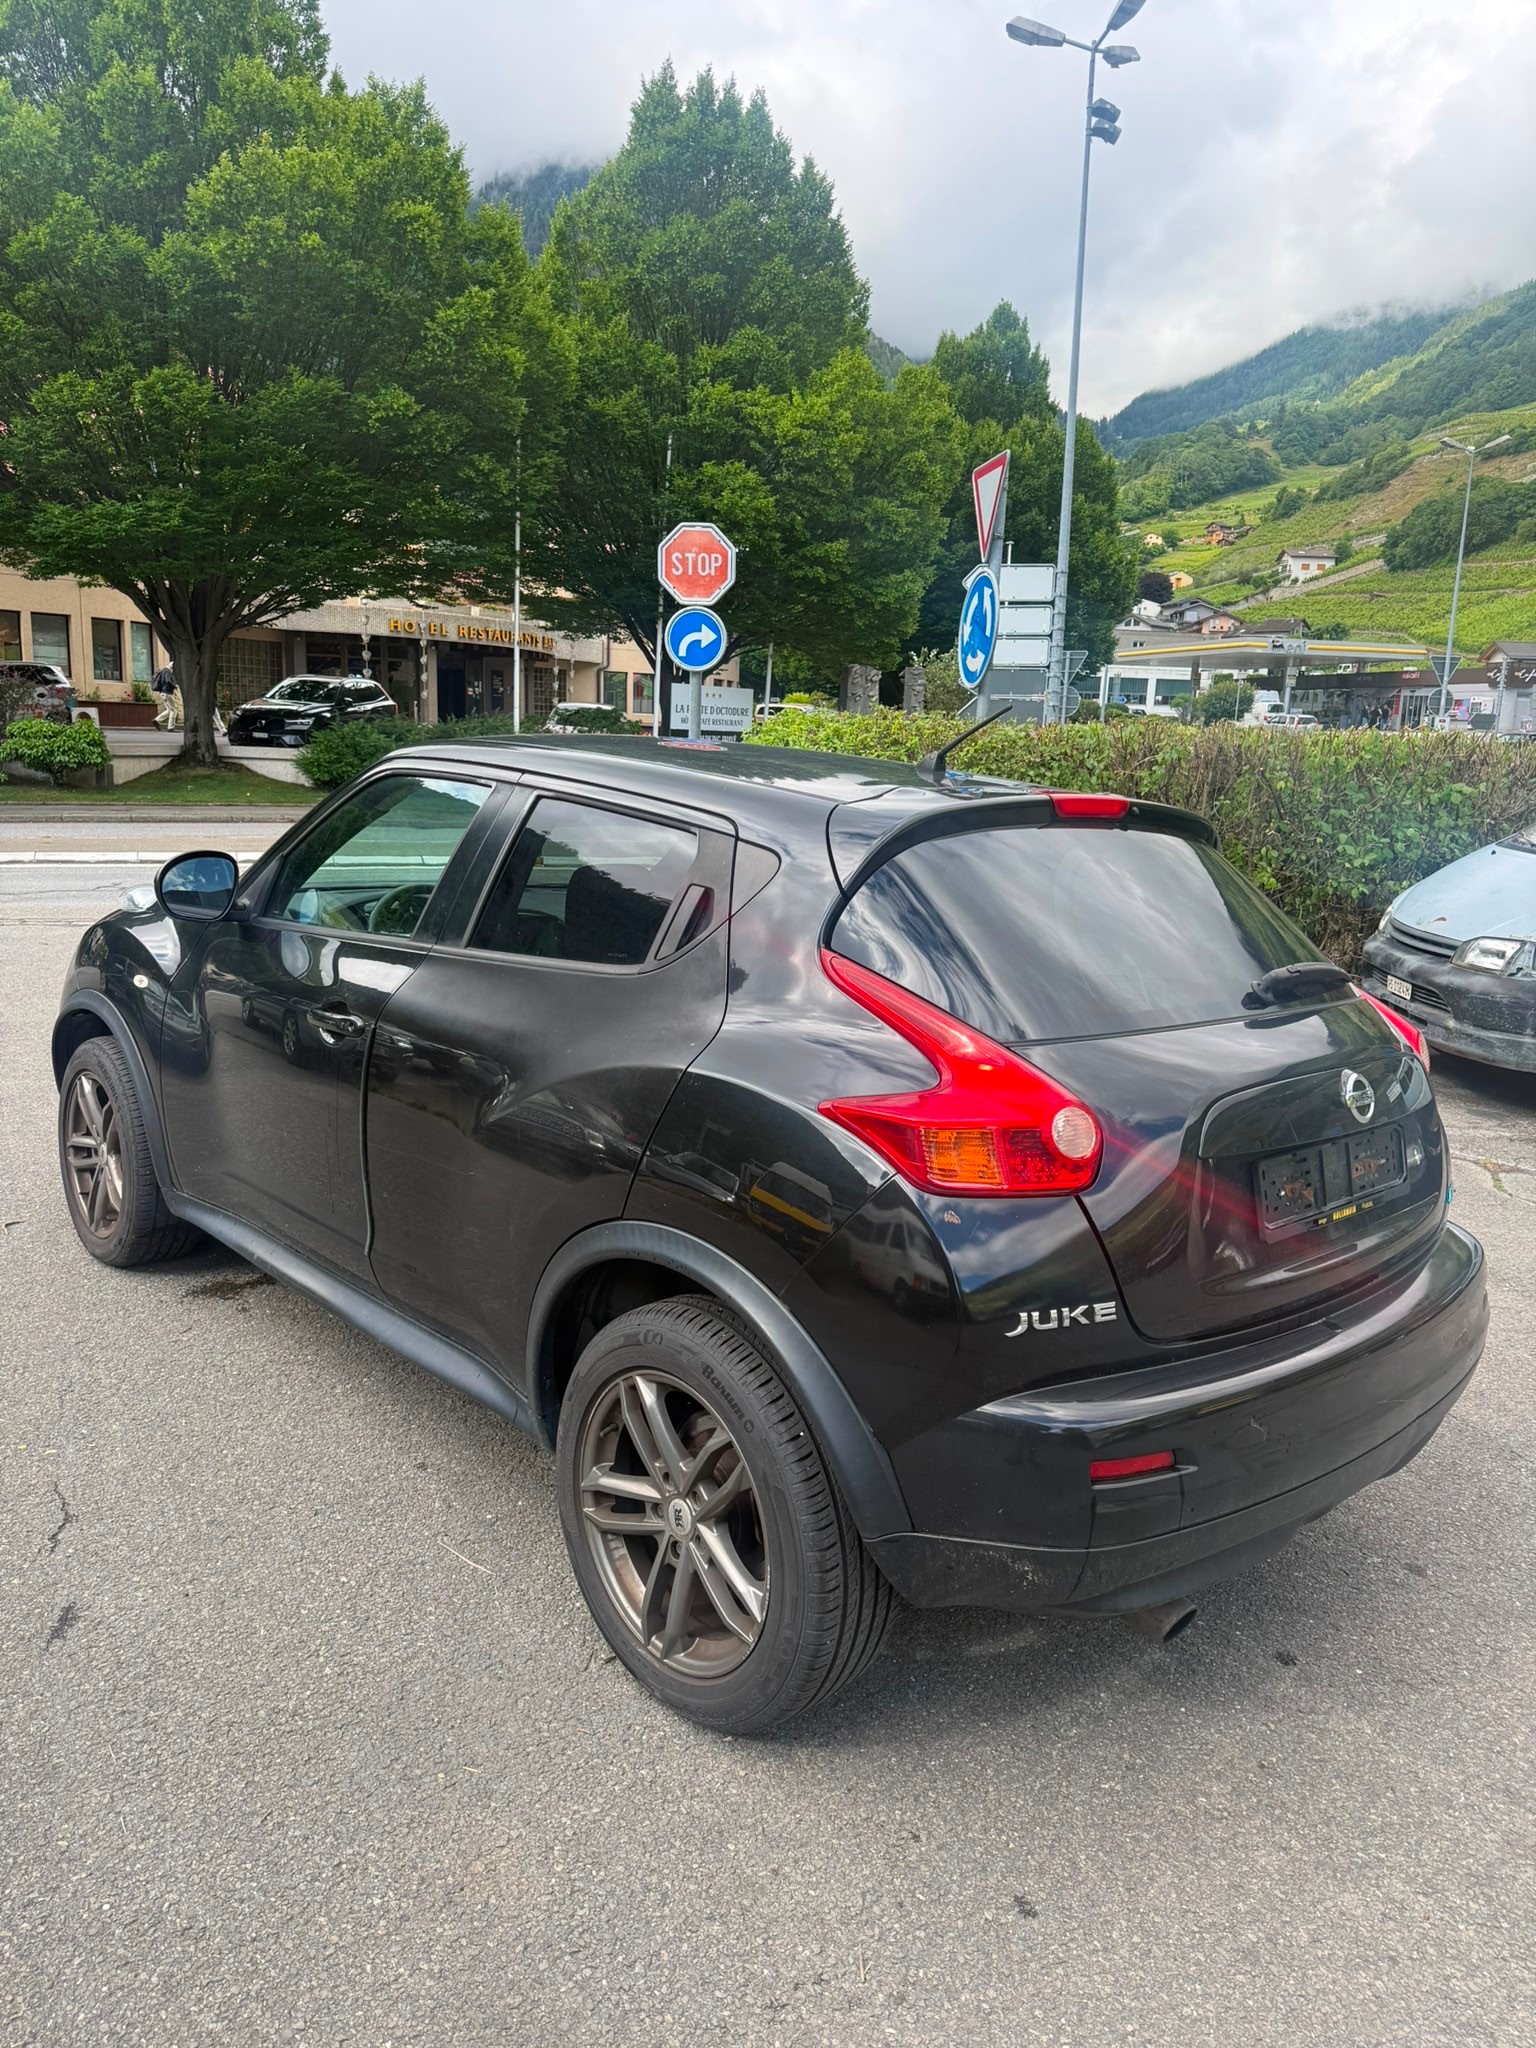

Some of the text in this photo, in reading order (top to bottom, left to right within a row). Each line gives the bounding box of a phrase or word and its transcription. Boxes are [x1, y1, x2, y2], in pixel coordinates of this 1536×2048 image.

[671, 552, 723, 577] STOP
[388, 618, 448, 636] HOEL
[675, 704, 749, 717] LA PTE D'OCTODURE
[712, 718, 744, 726] RESTAURANT
[1003, 1301, 1117, 1338] JUKE
[700, 1361, 746, 1422] Barum
